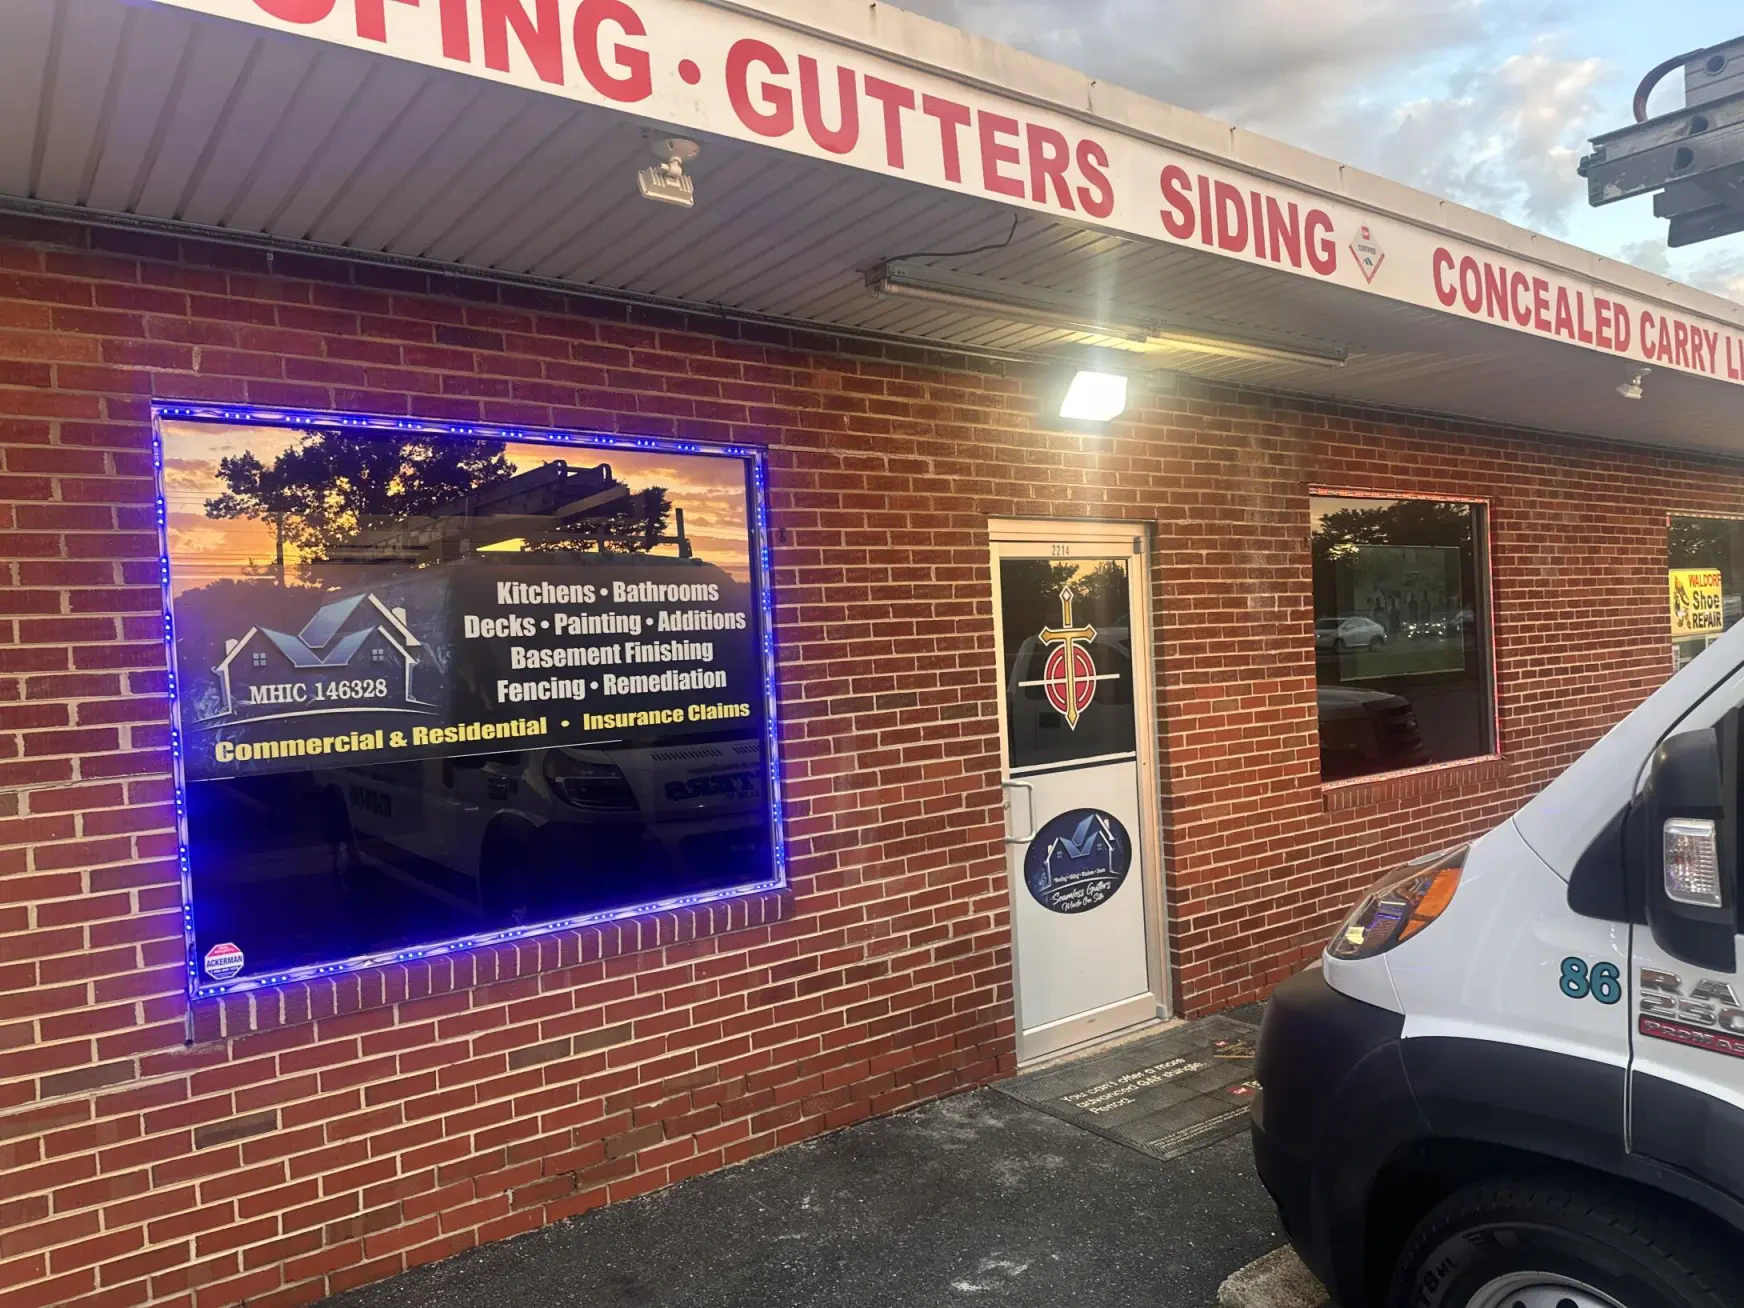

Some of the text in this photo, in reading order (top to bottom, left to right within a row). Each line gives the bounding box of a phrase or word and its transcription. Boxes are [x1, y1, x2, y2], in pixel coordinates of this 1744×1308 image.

[252, 0, 1337, 277] ING GUTTERS SIDING
[1432, 246, 1632, 353] CONCEALED
[1639, 311, 1718, 375] CARRY
[1052, 544, 1069, 556] 2214
[497, 580, 719, 605] Kitchens Bathrooms
[1689, 574, 1721, 587] WALDORF
[1692, 590, 1720, 610] Shoe
[464, 610, 746, 639] Decks Painting Additions
[1692, 612, 1721, 629] REPAIR
[511, 640, 714, 670] Basement Finishing
[250, 679, 388, 704] MHIC 146328
[497, 669, 727, 703] Fencing Remediation
[215, 702, 750, 763] Commercial & Residential Insurance Claims
[1053, 881, 1110, 905] Seamless Gutters
[207, 956, 242, 967] ACKERMAN
[1559, 956, 1622, 1005] 86
